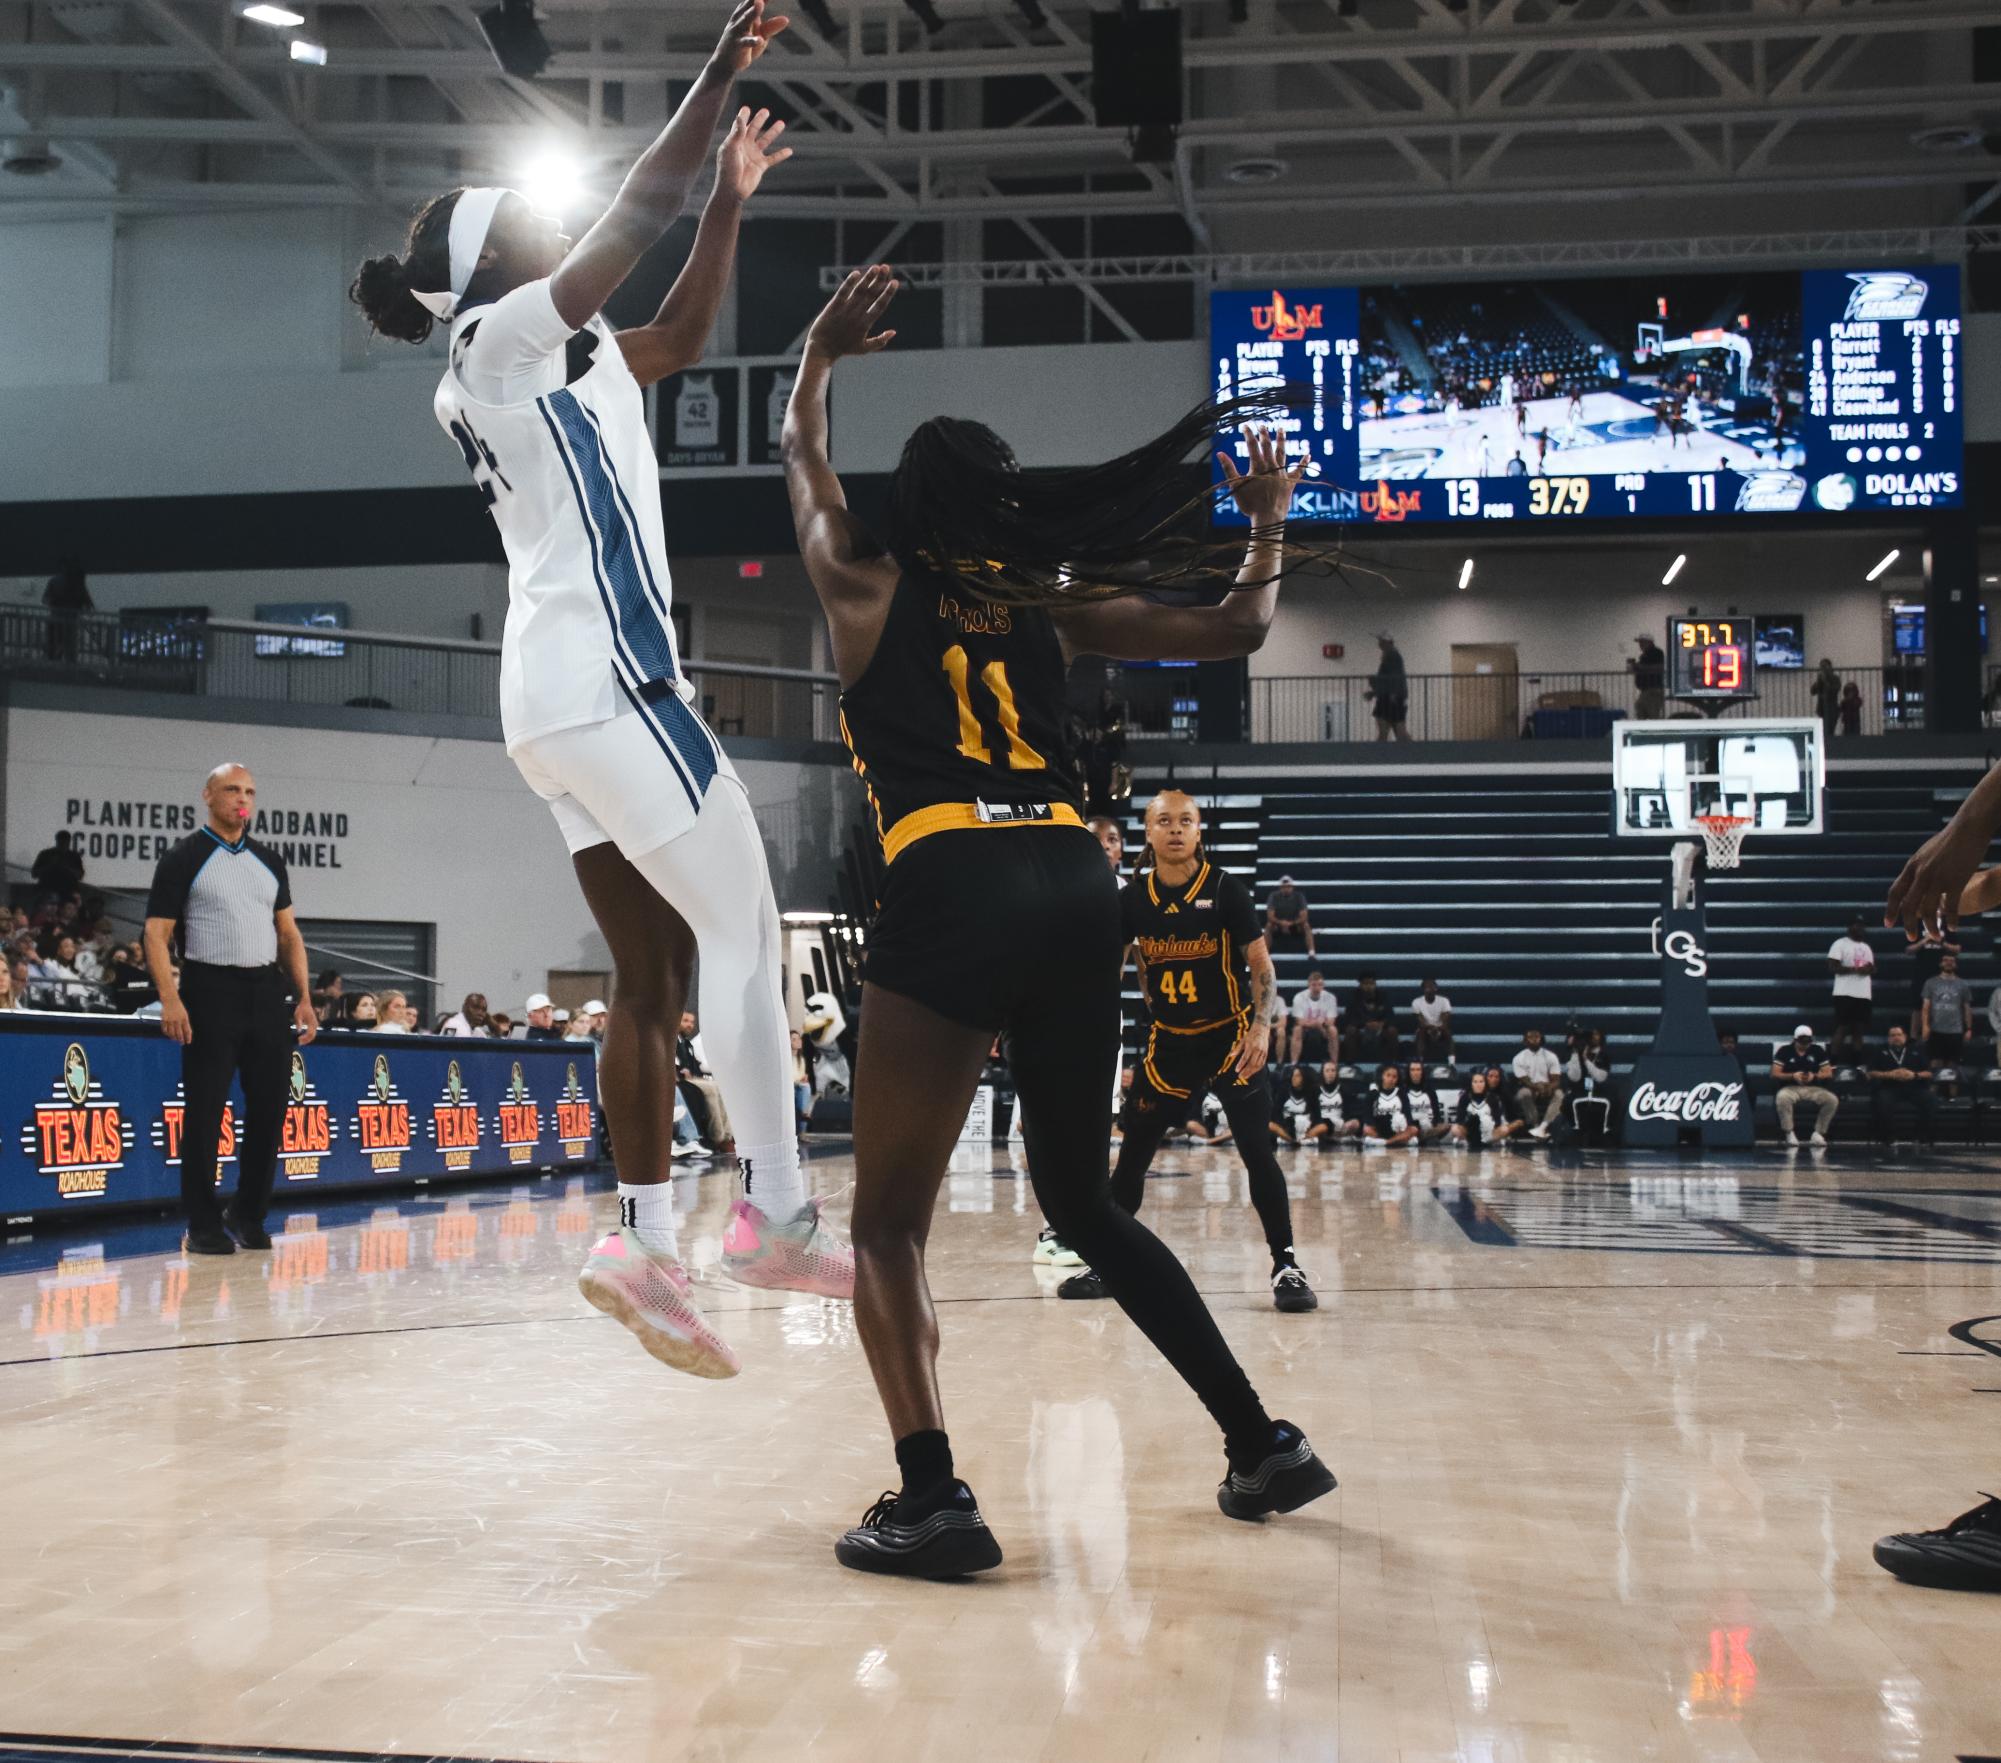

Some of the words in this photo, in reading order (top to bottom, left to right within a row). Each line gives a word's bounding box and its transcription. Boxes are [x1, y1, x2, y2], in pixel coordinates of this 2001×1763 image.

[1830, 322, 1880, 339] PLAYER
[1903, 320, 1929, 336] PTS
[1935, 319, 1960, 335] FLS
[1305, 340, 1330, 356] PTS
[1335, 339, 1359, 355] FLS
[1832, 338, 1881, 354] Garrett
[1912, 336, 1922, 352] 2
[1942, 335, 1953, 351] 0
[1809, 370, 1827, 386] 24
[1832, 369, 1896, 385] Anderson
[1912, 367, 1922, 382] 2
[1943, 366, 1953, 382] 0
[1813, 354, 1823, 370] 5
[1832, 354, 1877, 371] Bryant
[1943, 351, 1953, 366] 0
[1810, 401, 1827, 416] 41
[1832, 399, 1899, 416] Cleveland
[1913, 398, 1923, 413] 5
[1944, 397, 1954, 413] 0
[1832, 385, 1885, 402] Eddings
[1944, 382, 1954, 397] 0
[687, 402, 708, 419] 42
[1829, 424, 1866, 441] TEAM
[1867, 422, 1909, 439] FOULS
[1924, 422, 1934, 438] 2
[1445, 479, 1479, 516] 13
[1529, 478, 1590, 515] 37.9
[1688, 474, 1716, 511] 11
[1865, 472, 1957, 494] DOLAN'S
[1627, 494, 1636, 513] 1
[1682, 623, 1732, 648] 37.7
[1704, 647, 1740, 688] 13
[942, 645, 1047, 769] 11
[67, 798, 195, 831] PLANTERS
[254, 809, 348, 838] ADBAND
[73, 831, 174, 861] COOPER
[266, 841, 342, 868] NNEL
[1139, 932, 1218, 959] Warhawks
[1160, 970, 1198, 1004] 44
[1628, 1081, 1744, 1121] Coca-Cola
[278, 1105, 329, 1152] EXAS
[358, 1104, 410, 1148] TEXAS
[434, 1106, 480, 1148] TEXAS
[500, 1105, 539, 1143] TEXAS
[557, 1103, 591, 1139] TEXAS
[37, 1108, 121, 1166] TEXAS
[58, 1170, 107, 1193] ROADHOUSE
[285, 1157, 320, 1176] ROADHOUSE
